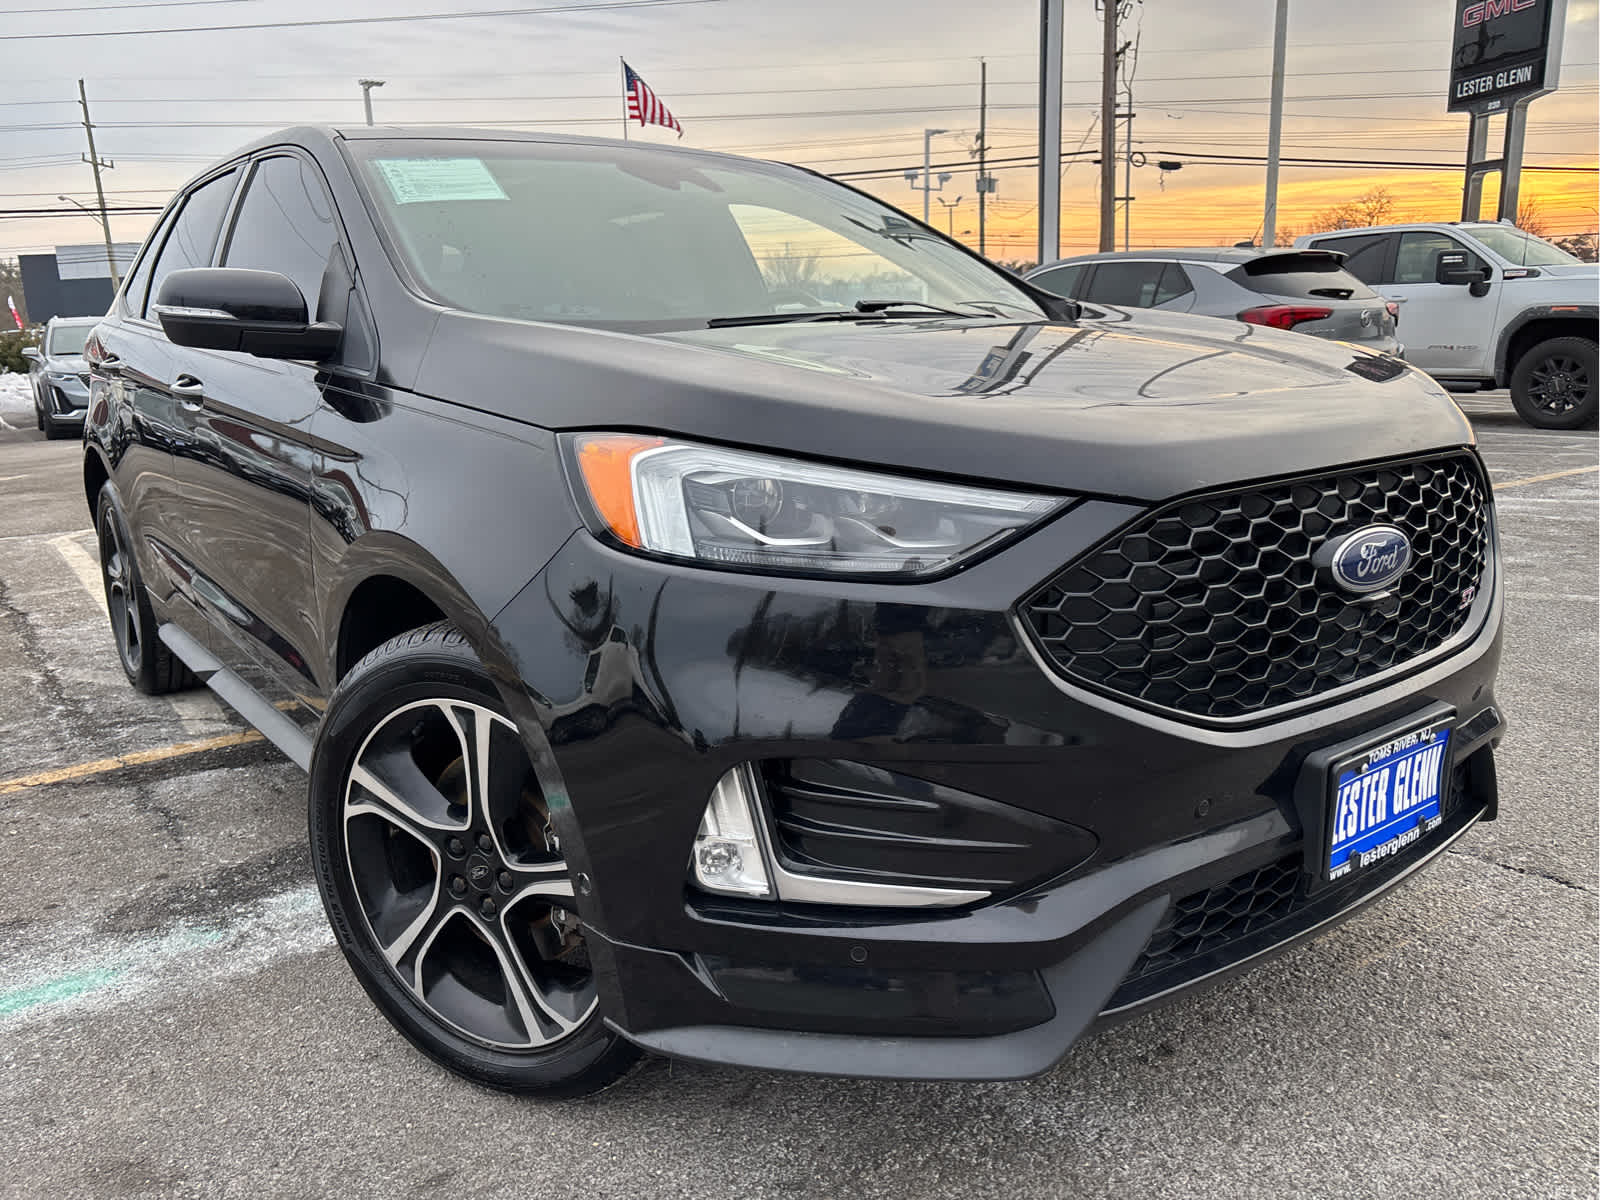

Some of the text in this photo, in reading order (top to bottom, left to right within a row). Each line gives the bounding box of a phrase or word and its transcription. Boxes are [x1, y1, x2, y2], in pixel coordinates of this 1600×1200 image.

[1457, 66, 1532, 98] LESTER GLENN
[1357, 540, 1398, 577] Ford
[1369, 744, 1391, 764] TOMS
[1420, 728, 1431, 742] NJ
[1393, 745, 1443, 815] GLENN
[1329, 863, 1351, 881] www.
[1359, 829, 1420, 868] lesterglenn
